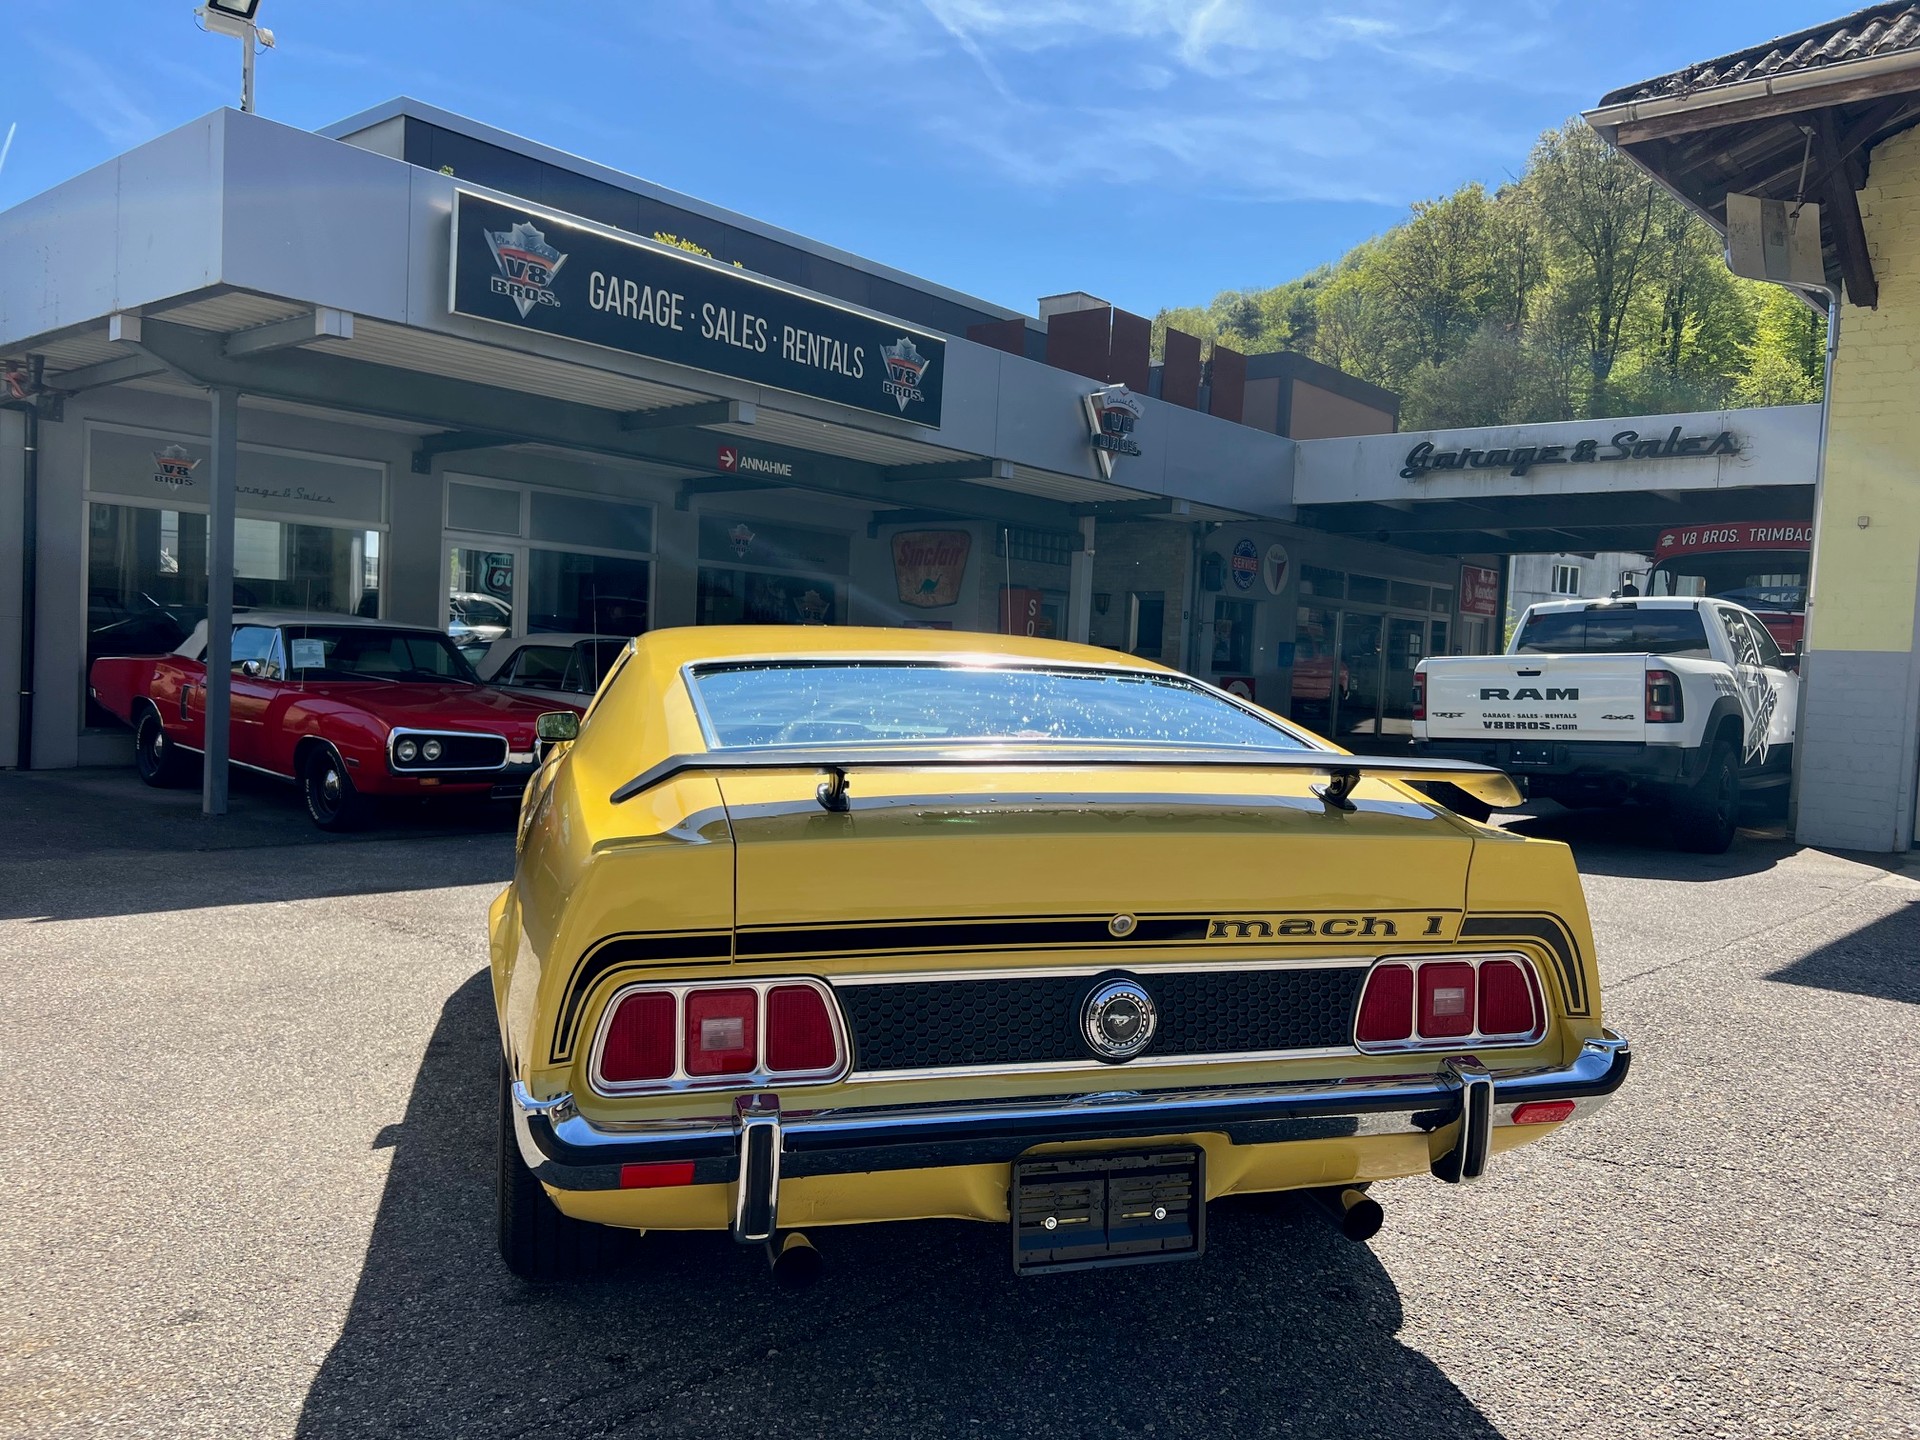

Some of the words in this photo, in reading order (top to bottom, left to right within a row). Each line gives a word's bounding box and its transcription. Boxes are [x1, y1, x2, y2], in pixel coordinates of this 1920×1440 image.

[503, 254, 549, 287] V8
[490, 275, 561, 309] BROS.
[588, 270, 685, 332] GARAGE
[701, 302, 768, 354] SALES
[783, 326, 865, 379] RENTALS
[890, 362, 918, 387] V8
[882, 380, 925, 403] BROS.
[1399, 440, 1567, 479] Garage
[1570, 438, 1598, 463] &
[1600, 426, 1740, 461] Sales
[161, 463, 189, 476] V8
[740, 456, 793, 477] ANNAHME
[234, 486, 283, 499] arage
[293, 486, 336, 504] Sales
[1681, 532, 1698, 546] V8
[1702, 529, 1740, 545] BROS.
[1749, 527, 1813, 542] TRIMBAC
[1233, 556, 1258, 571] SERVICE
[1480, 688, 1580, 701] RAM
[1482, 720, 1578, 731] V8BROS.com
[1209, 915, 1398, 939] mach
